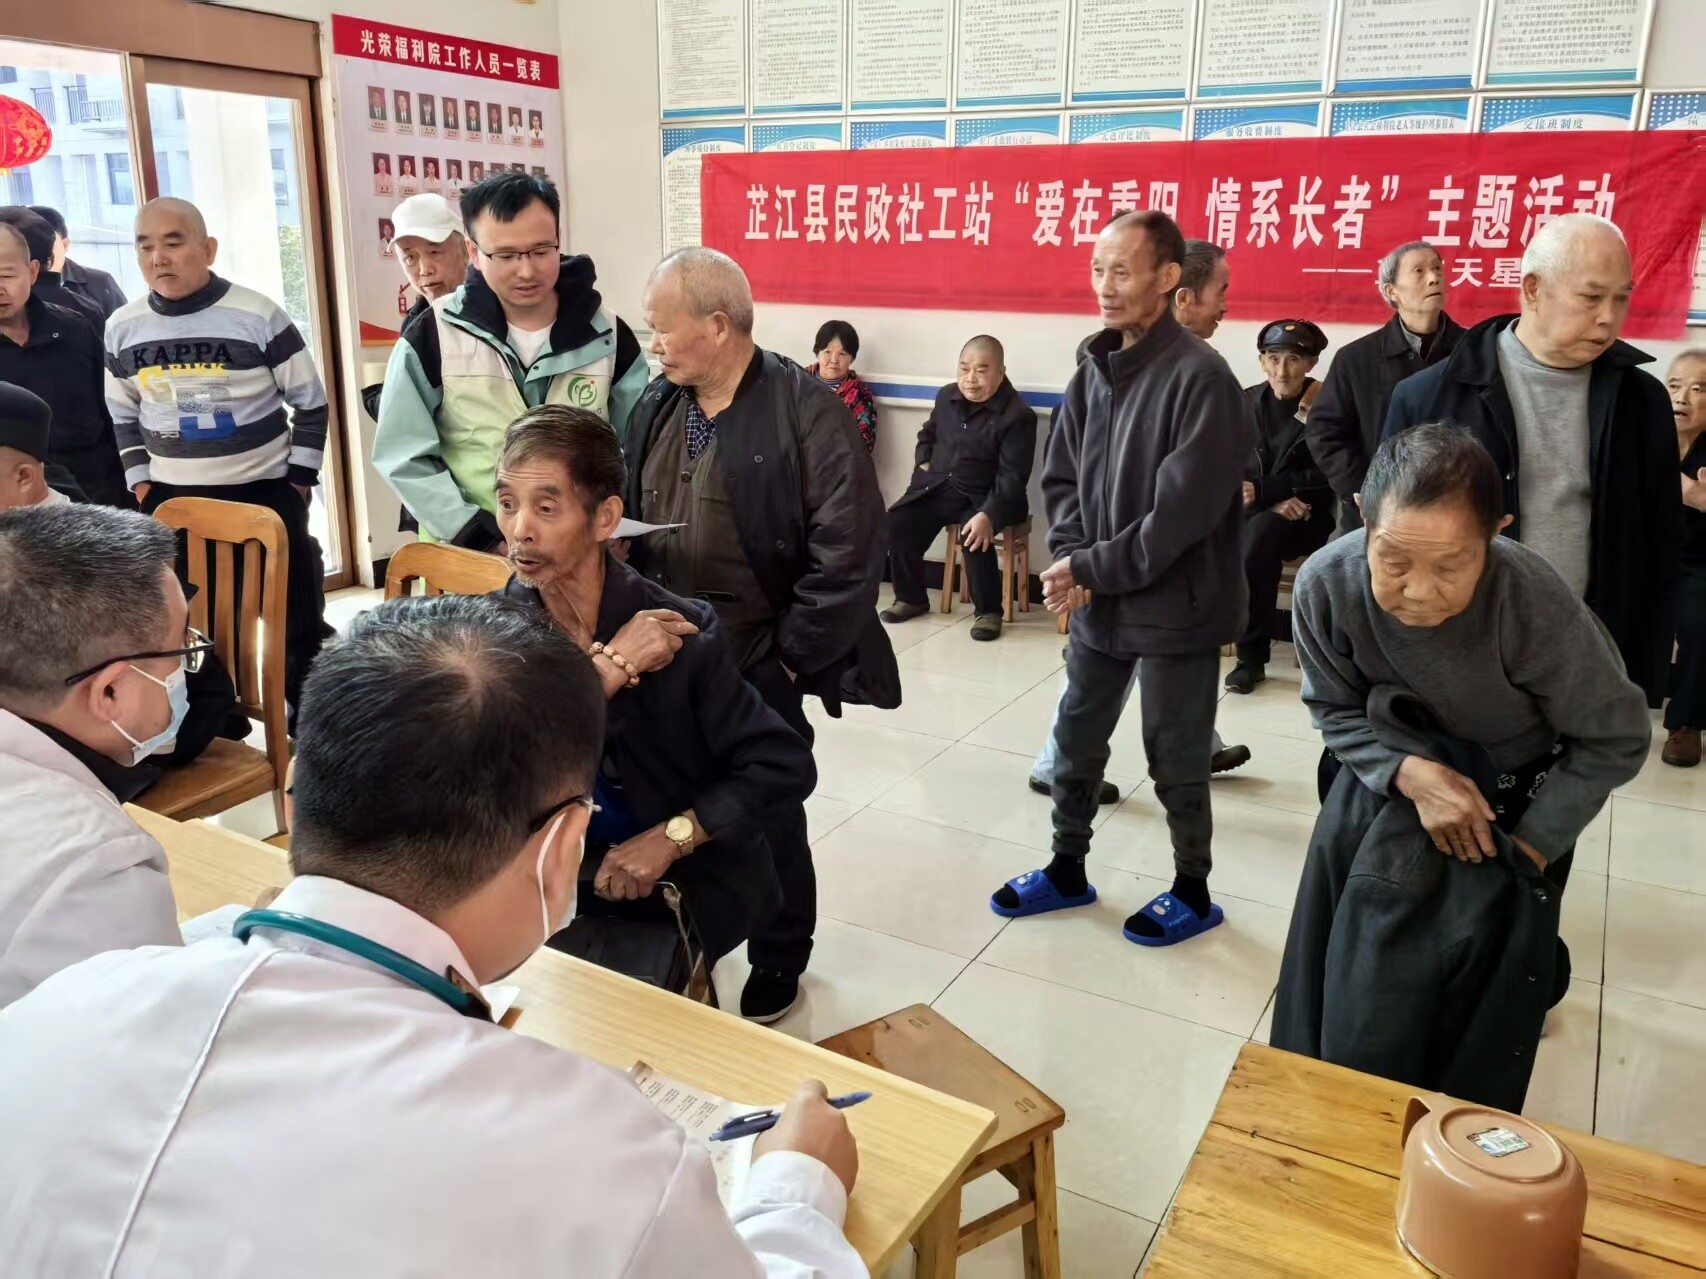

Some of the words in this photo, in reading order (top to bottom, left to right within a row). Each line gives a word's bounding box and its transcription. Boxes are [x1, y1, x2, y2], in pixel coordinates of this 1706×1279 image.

[360, 29, 541, 81] 光荣福利院工作人员一览表
[132, 342, 235, 369] KAPPA
